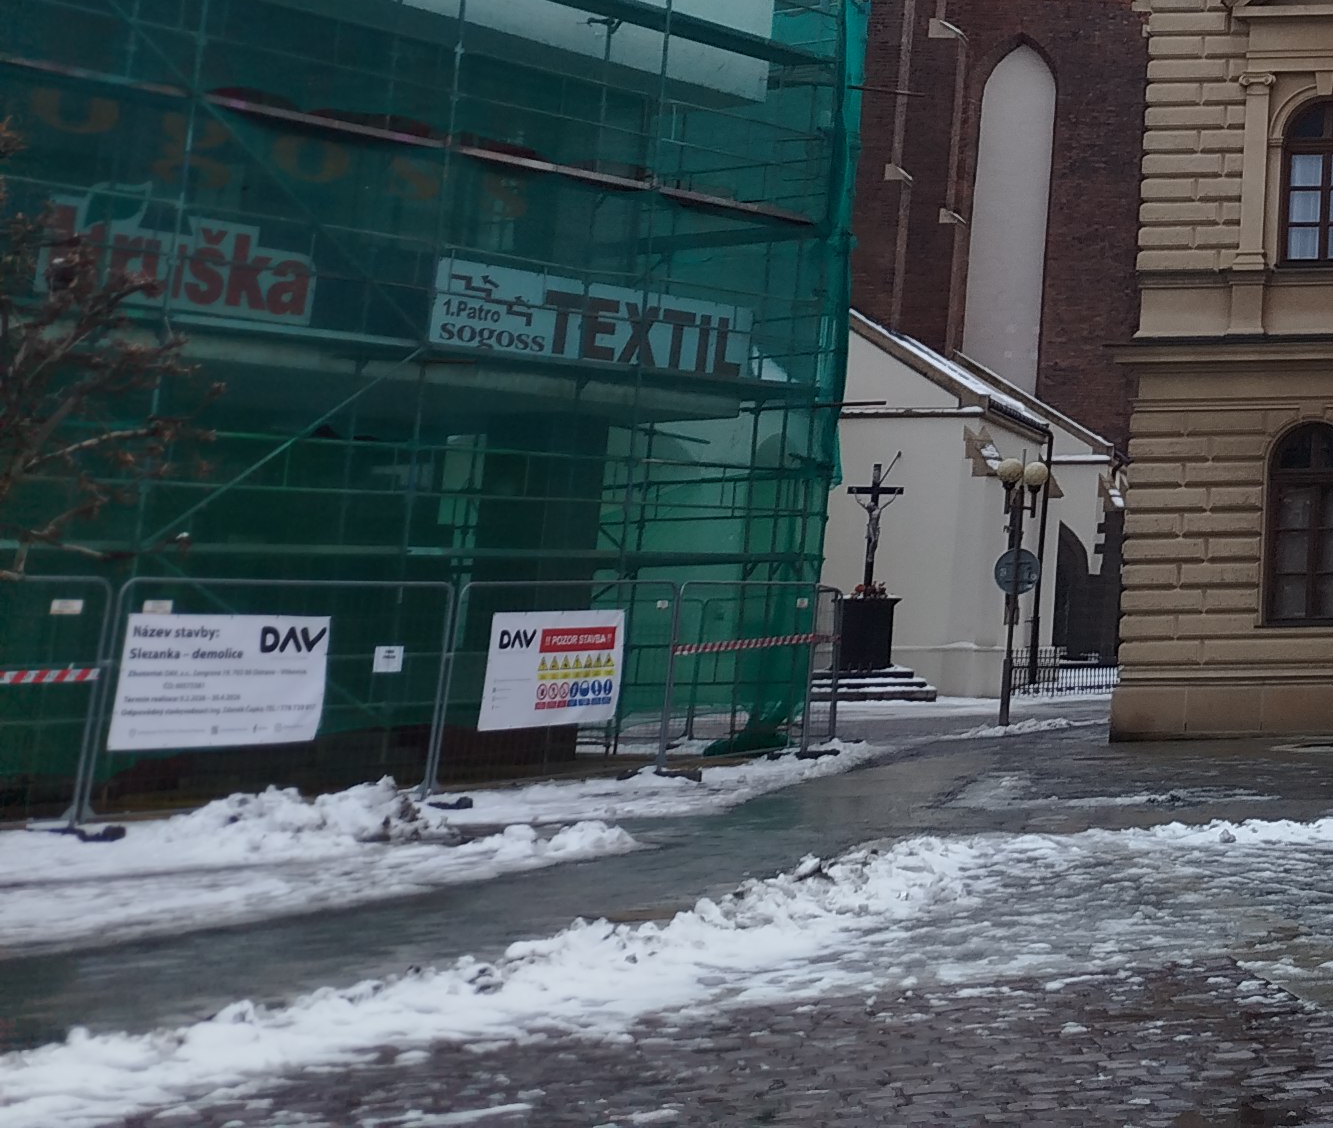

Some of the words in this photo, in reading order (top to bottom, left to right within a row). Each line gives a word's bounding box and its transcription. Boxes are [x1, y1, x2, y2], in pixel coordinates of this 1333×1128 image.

[442, 298, 501, 324] 1.Patro
[438, 320, 546, 353] sogoss
[545, 288, 742, 377] TEXTIL
[132, 625, 172, 638] Název
[173, 625, 221, 641] stavby:
[259, 625, 328, 654] DAV
[498, 628, 538, 650] DAV
[551, 635, 578, 646] POZOR
[578, 633, 606, 645] STAVBA
[129, 647, 181, 660] Slezanka
[192, 648, 244, 660] demolice
